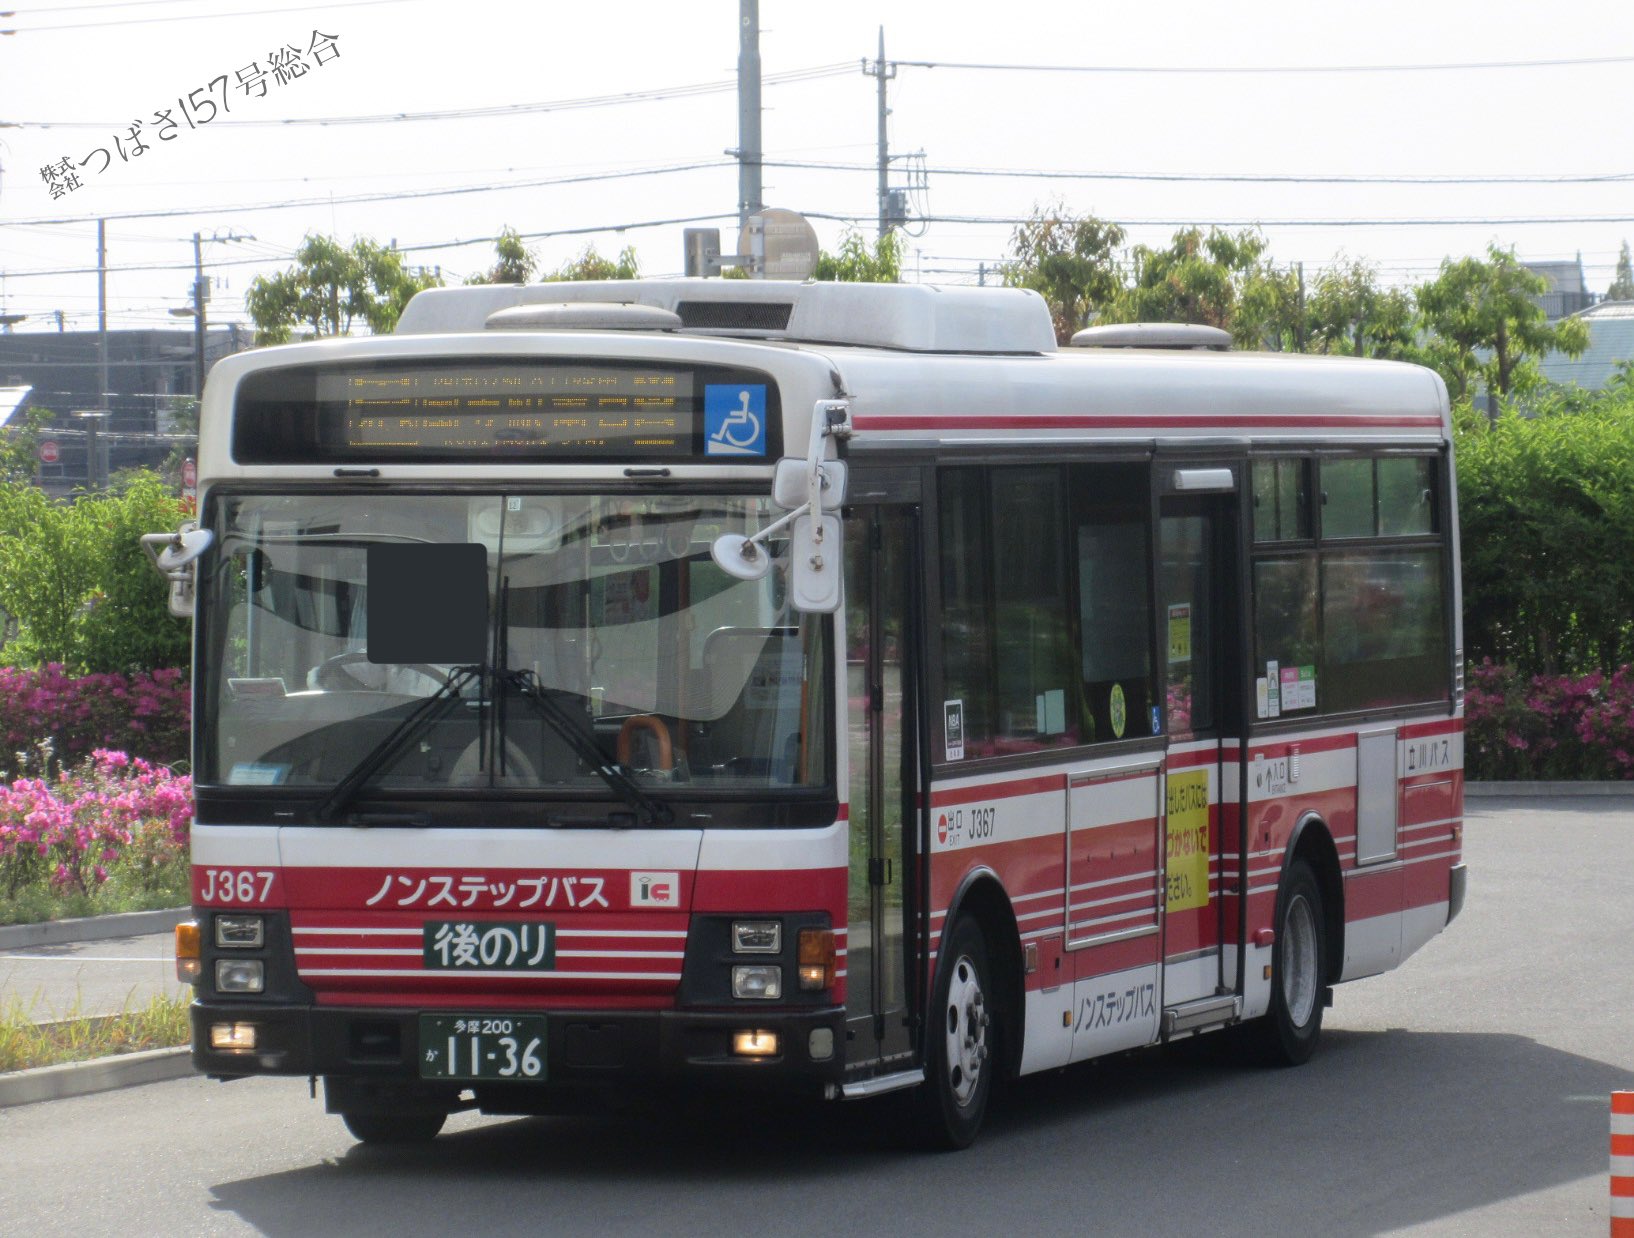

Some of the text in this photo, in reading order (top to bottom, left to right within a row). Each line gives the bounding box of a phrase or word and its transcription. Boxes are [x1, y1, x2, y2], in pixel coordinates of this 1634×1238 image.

[1273, 762, 1285, 781] 入口
[1408, 740, 1449, 770] 立川バス
[947, 810, 962, 831] 出口
[968, 807, 996, 840] J367
[949, 834, 960, 847] EXIT
[201, 869, 275, 903] J367
[366, 874, 609, 908] ノンステップバス
[433, 923, 546, 967] 後のり
[1075, 983, 1154, 1034] ノンステップバス
[454, 1019, 512, 1034] 多摩 200
[425, 1036, 541, 1077] か 11-36
